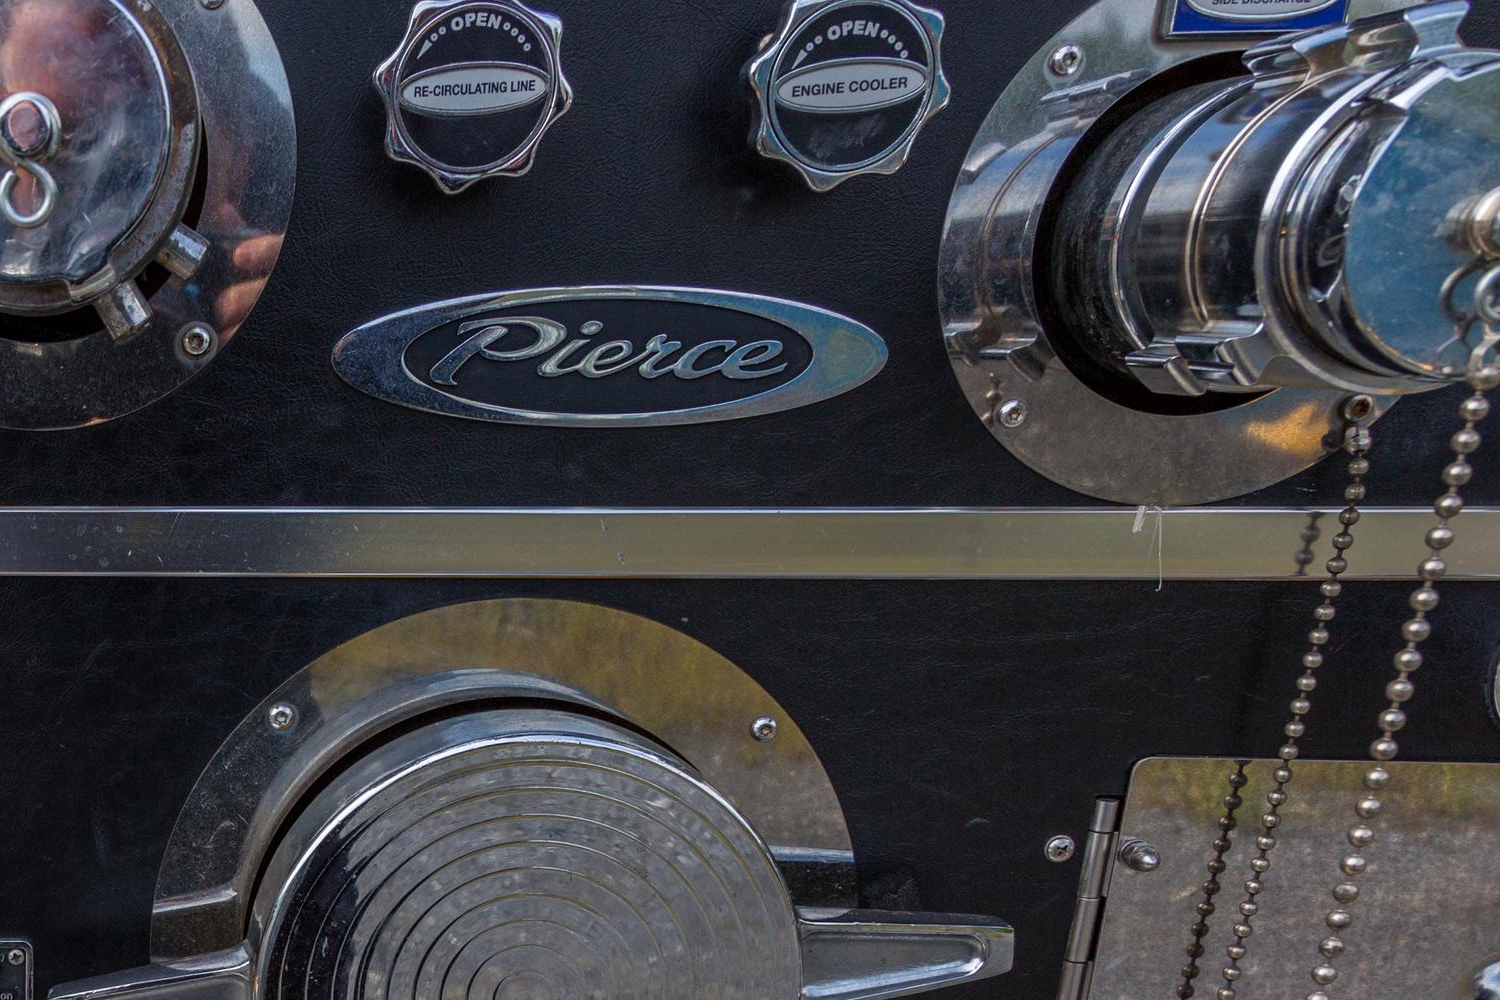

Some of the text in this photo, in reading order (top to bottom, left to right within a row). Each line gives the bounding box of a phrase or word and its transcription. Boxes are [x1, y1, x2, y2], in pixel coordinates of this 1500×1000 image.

[451, 13, 501, 31] OPEN
[827, 20, 880, 40] OPEN
[414, 80, 535, 97] RE-CIRCULATING LINE
[792, 77, 908, 97] ENGINE COOLER
[430, 316, 788, 385] Pierce
